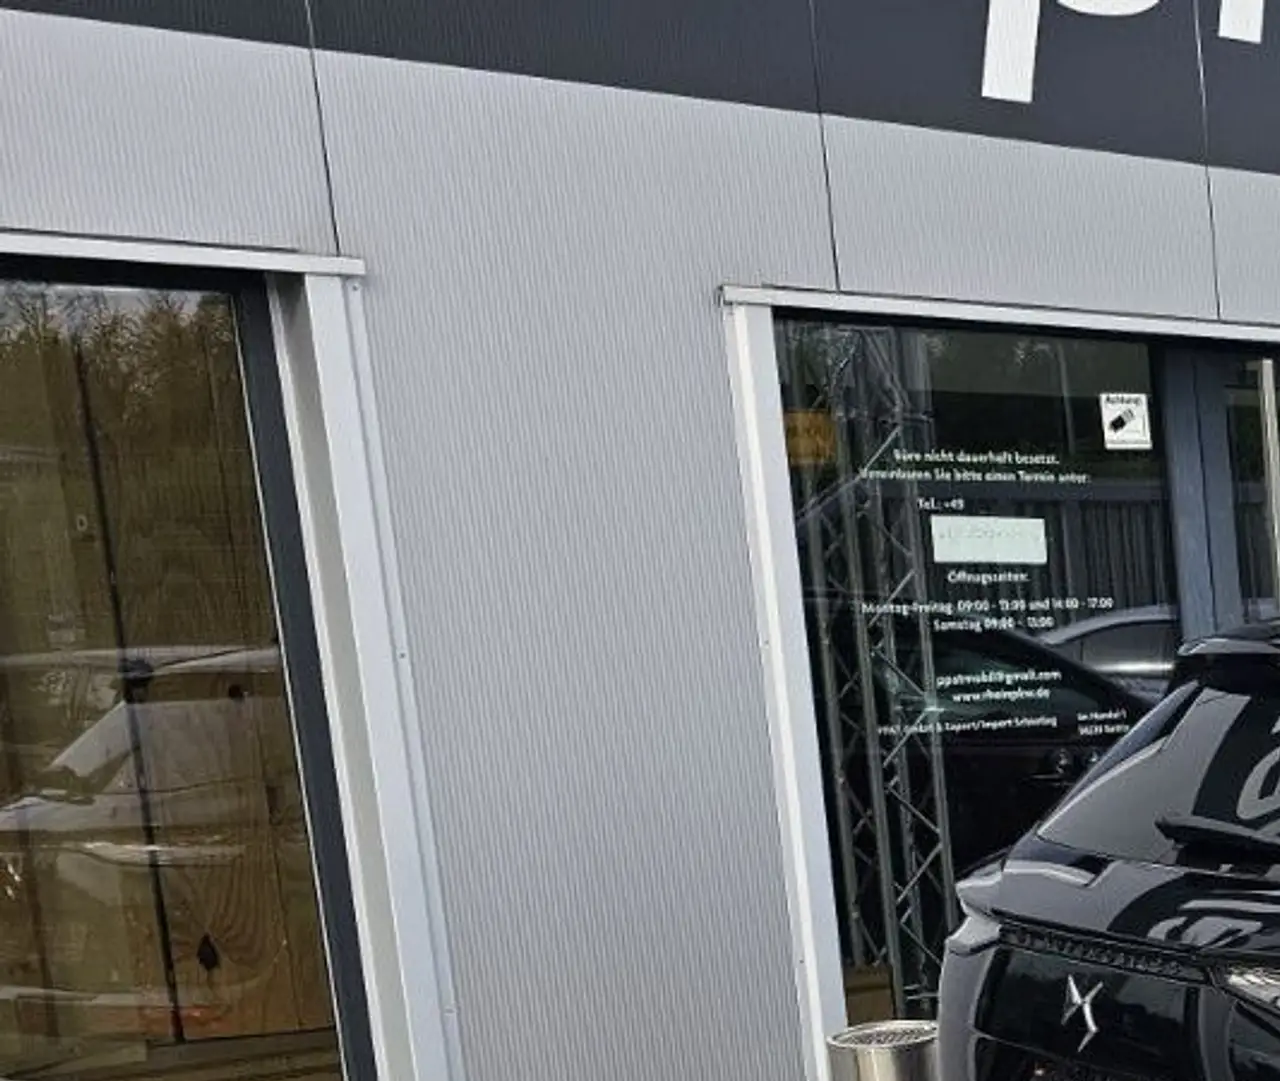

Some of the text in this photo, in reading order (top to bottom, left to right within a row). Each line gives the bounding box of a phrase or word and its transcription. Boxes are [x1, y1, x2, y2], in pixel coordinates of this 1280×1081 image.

[924, 449, 954, 463] nicht
[957, 450, 1012, 464] dauerhaft
[934, 467, 951, 481] Sie
[953, 468, 982, 482] bitte
[984, 471, 1016, 482] einen
[1018, 470, 1056, 482] Termin
[1029, 597, 1050, 611] und
[933, 618, 982, 633] Samstag
